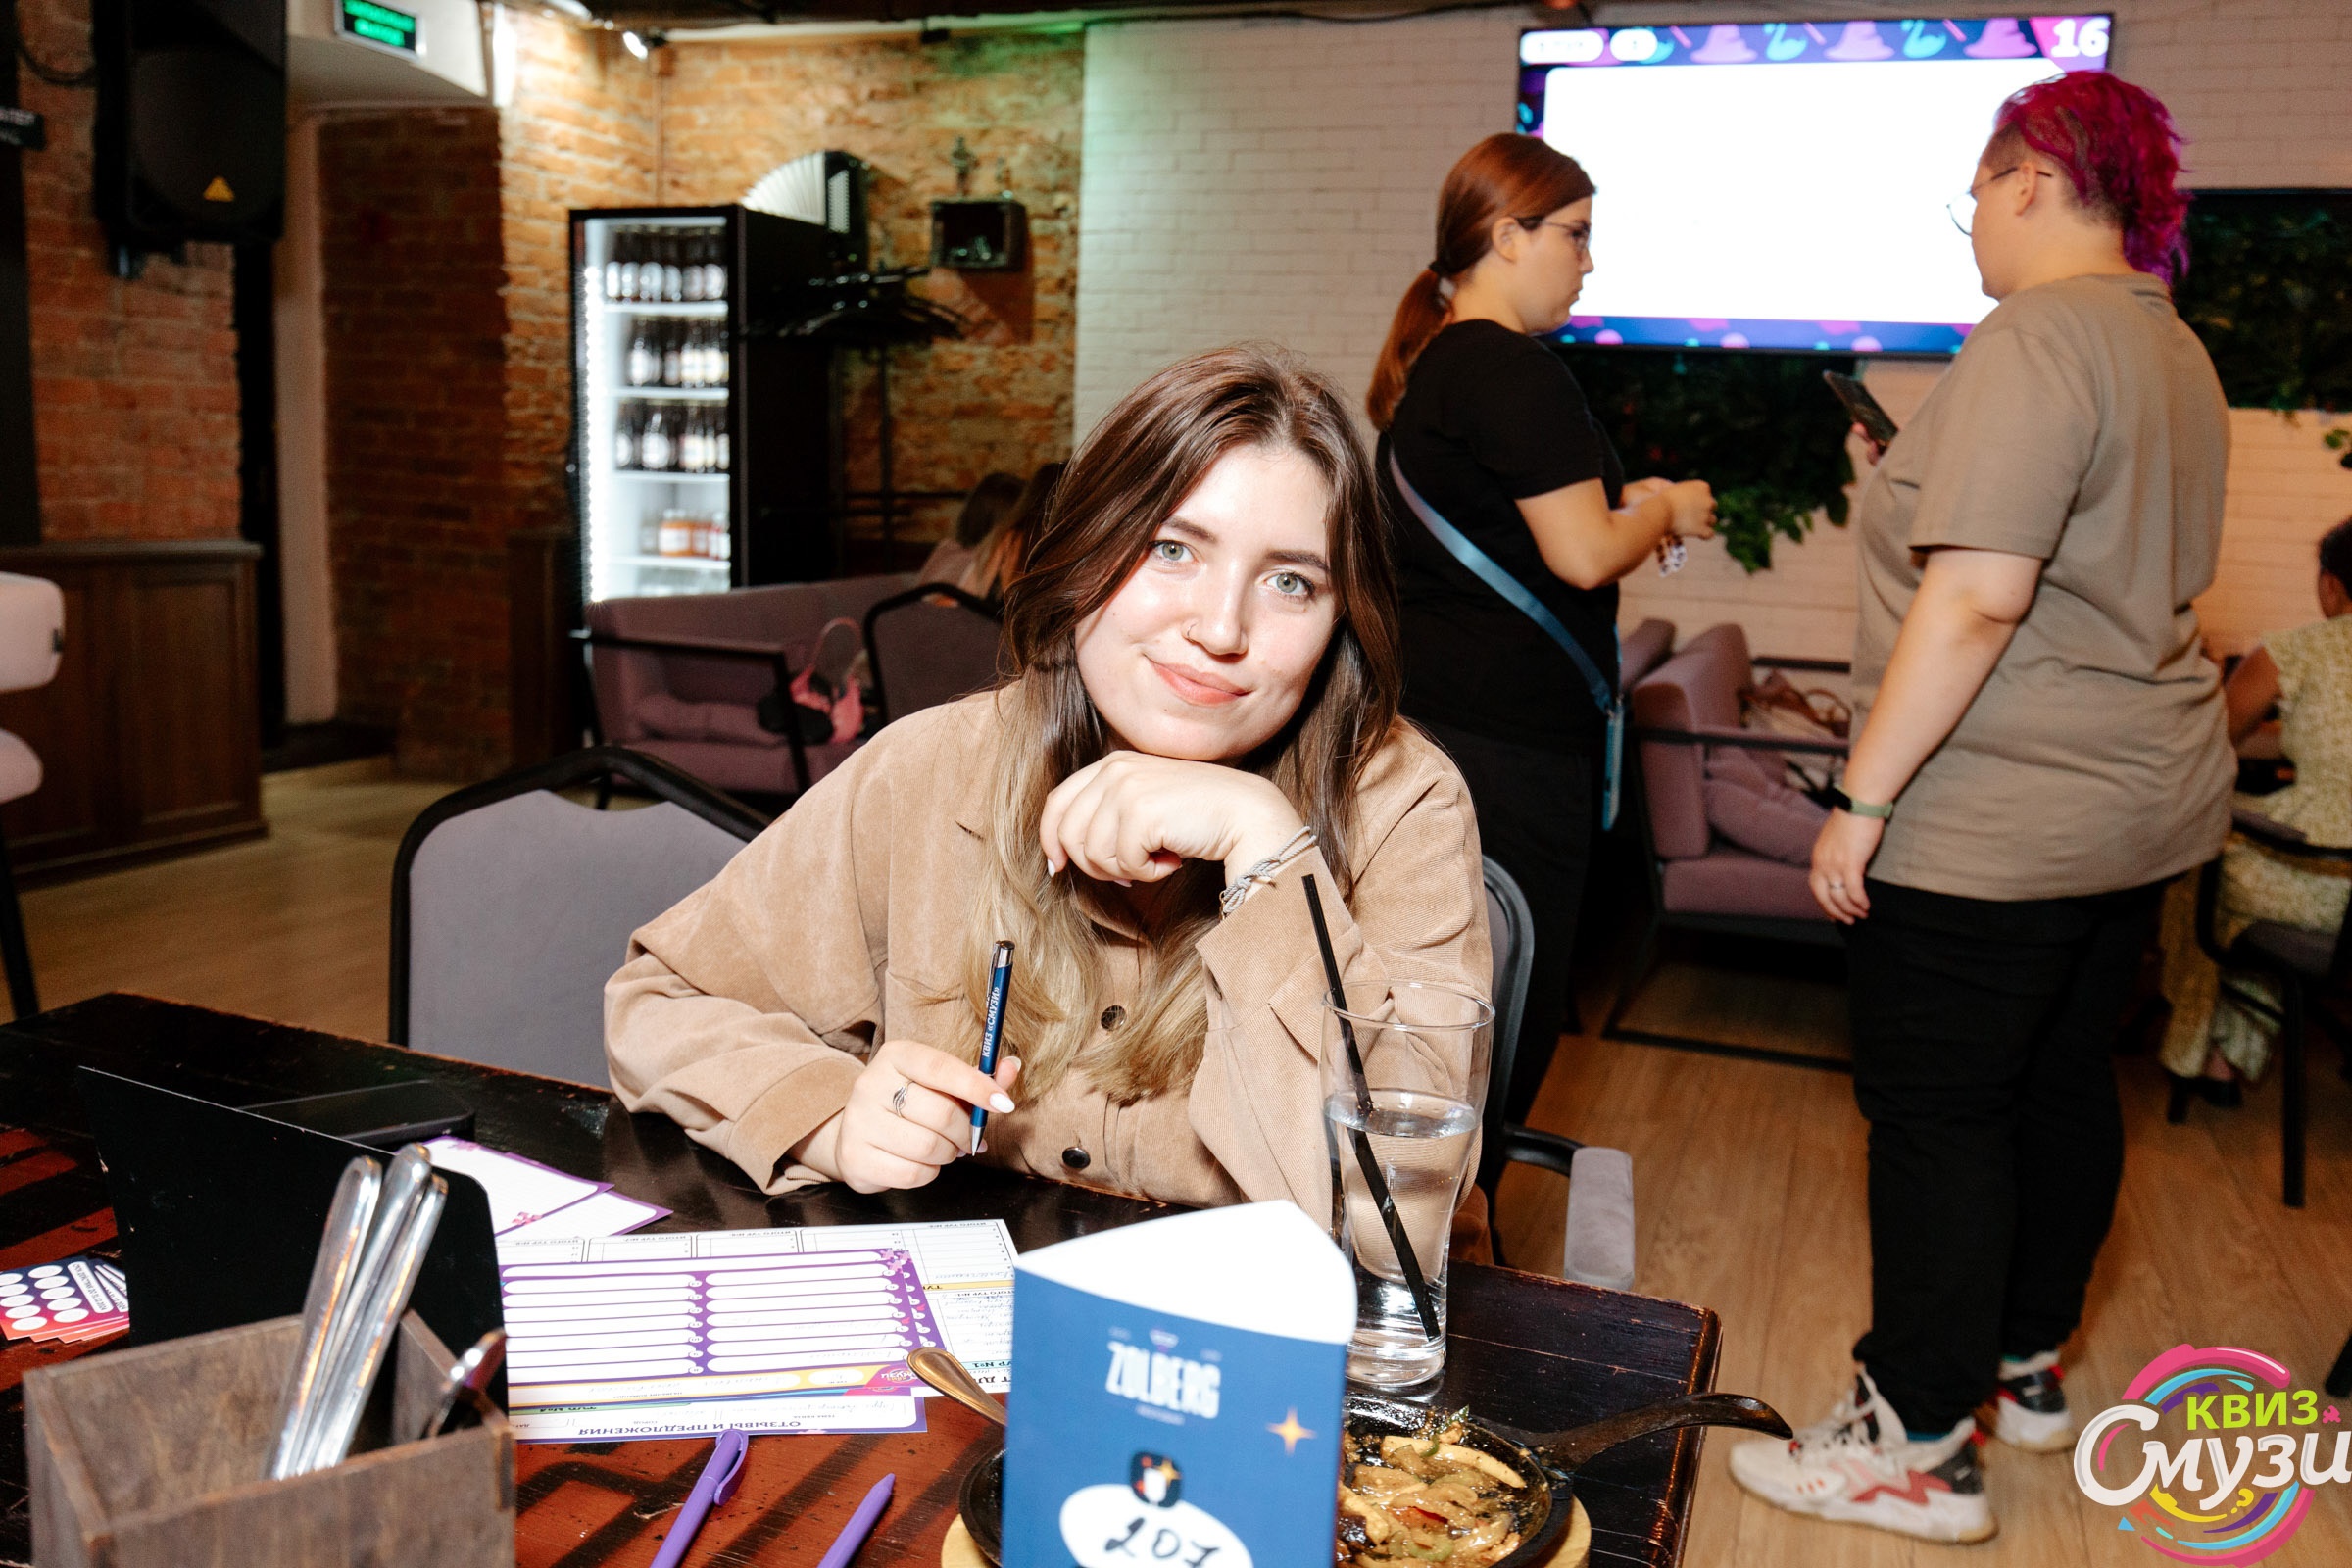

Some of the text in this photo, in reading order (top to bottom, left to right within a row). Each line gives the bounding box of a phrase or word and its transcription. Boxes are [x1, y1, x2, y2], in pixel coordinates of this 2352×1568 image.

[2050, 17, 2111, 58] 16
[982, 987, 1000, 1058] КВИЗ «СМУЗИ»
[1105, 1340, 1221, 1420] ZOLBERG
[578, 1424, 707, 1436] ПРЕДЛОЖЕНИЯ
[730, 1420, 801, 1429] ОТЗЫВЫ
